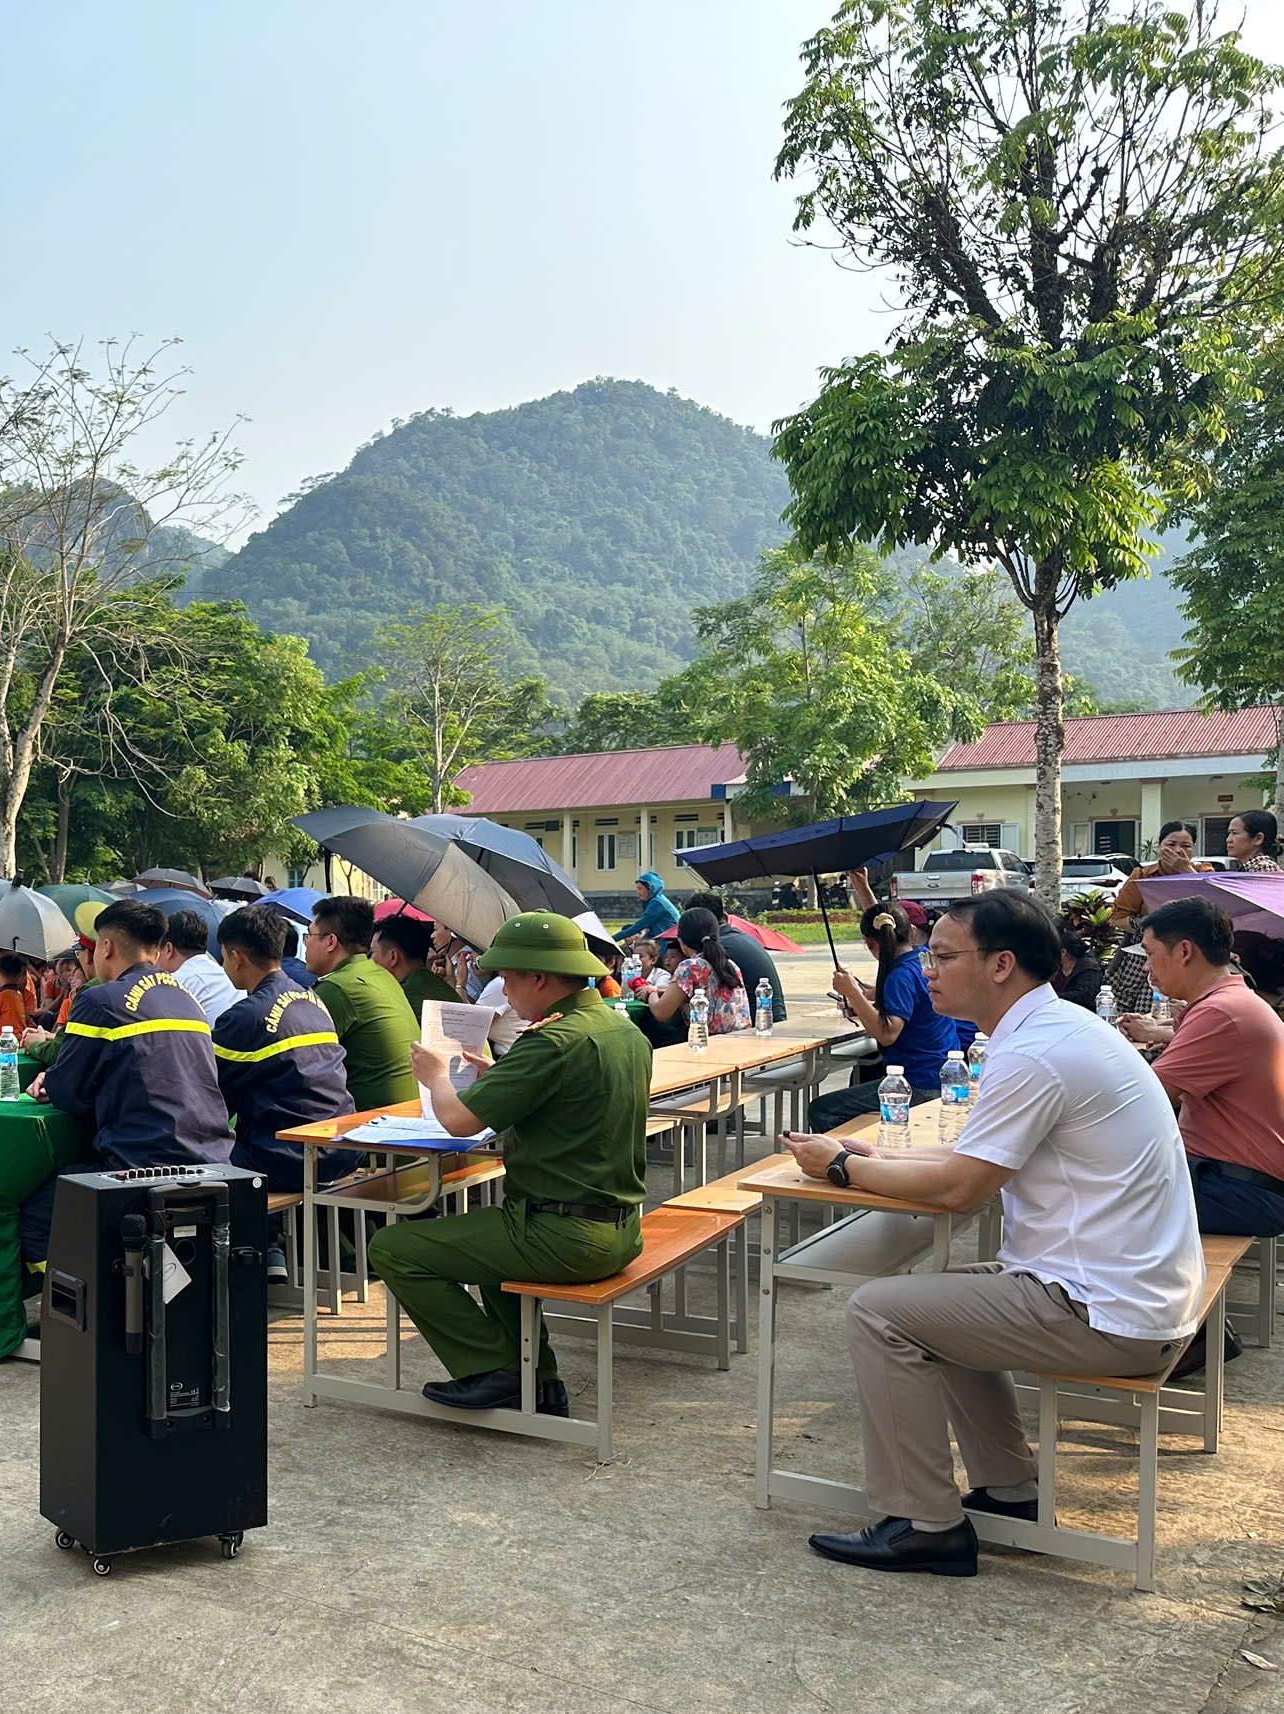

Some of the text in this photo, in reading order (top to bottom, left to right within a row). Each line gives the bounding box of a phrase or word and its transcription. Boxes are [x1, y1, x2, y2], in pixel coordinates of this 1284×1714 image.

[123, 984, 145, 1012] CẢNH
[138, 974, 157, 991] SÁT
[264, 1003, 284, 1033] CẢNH
